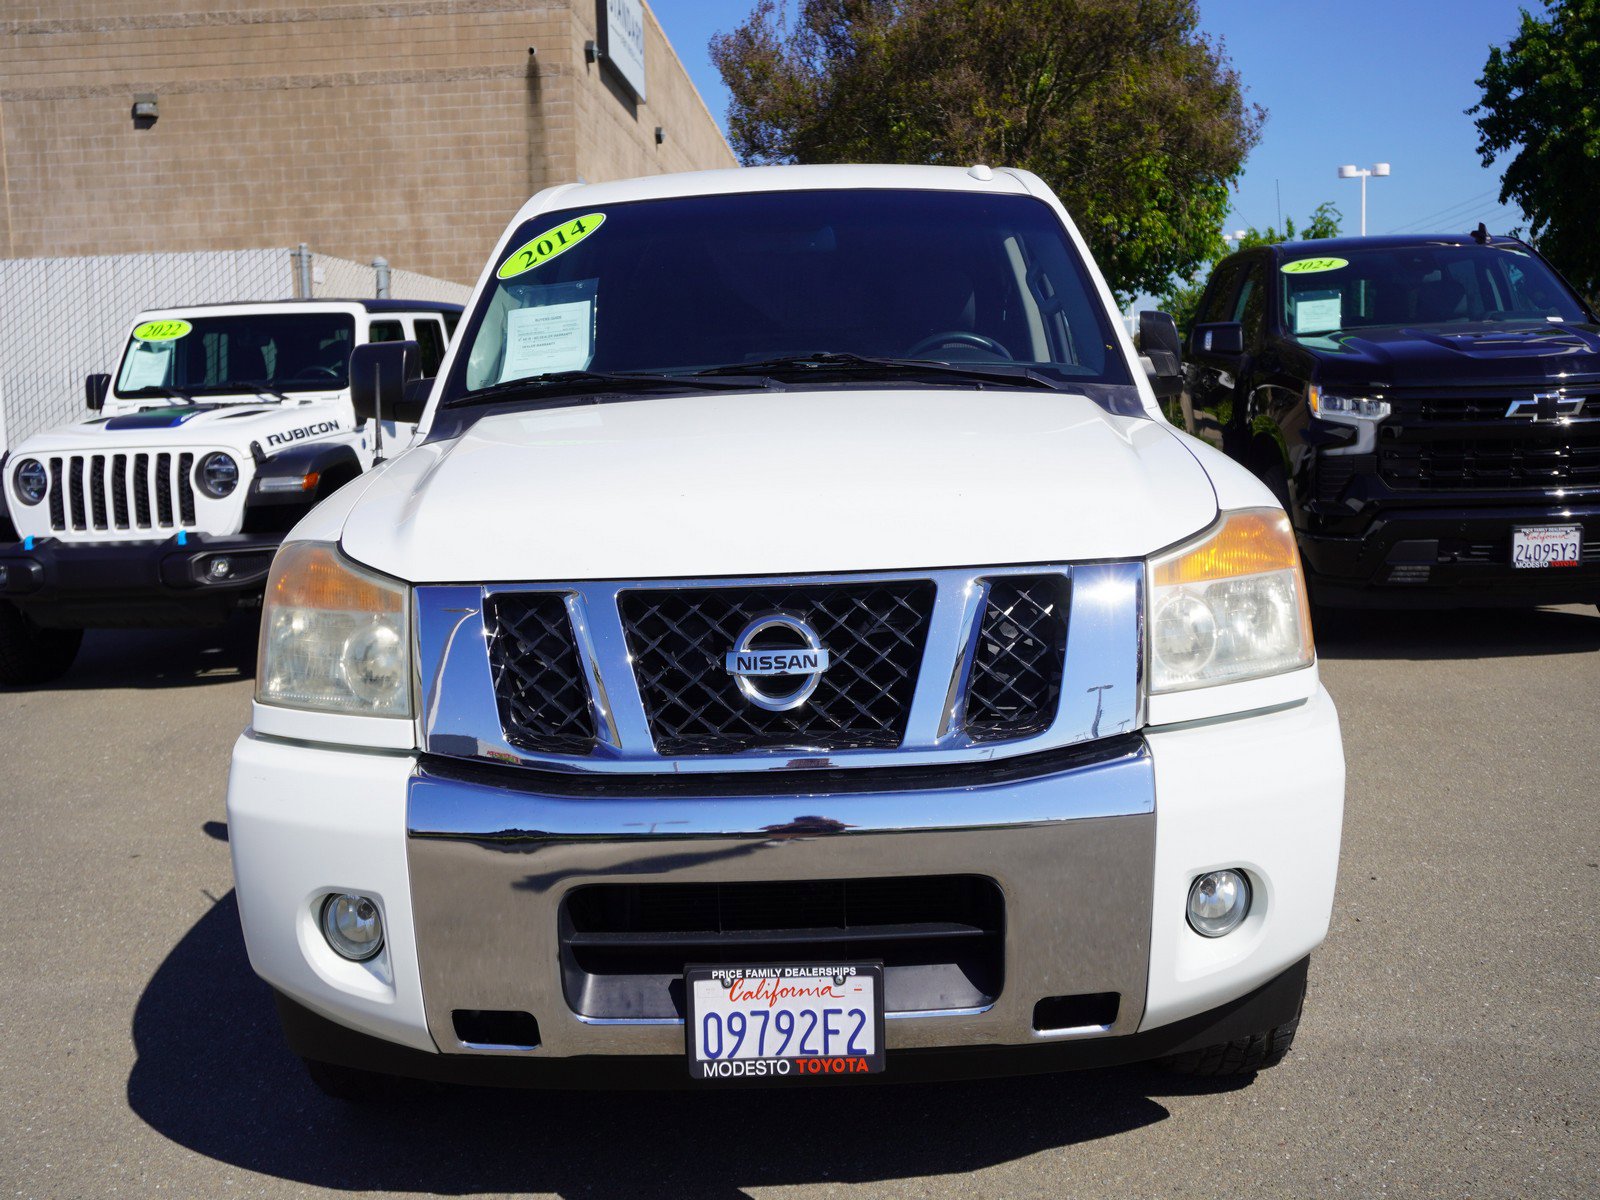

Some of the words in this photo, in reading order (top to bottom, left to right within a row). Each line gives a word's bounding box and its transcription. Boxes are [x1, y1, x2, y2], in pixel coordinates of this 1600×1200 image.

[519, 219, 587, 269] 2014
[1291, 260, 1335, 272] 2024
[142, 323, 182, 338] 2022
[266, 419, 340, 446] RUBICON
[1516, 543, 1577, 562] 24095Y3
[737, 654, 818, 671] NISSAN
[711, 969, 743, 979] PRICE
[745, 968, 783, 978] FAMILY
[784, 967, 857, 977] DEALERSHIPS
[729, 977, 845, 1007] California
[703, 1008, 868, 1060] 09792F2
[703, 1059, 791, 1078] MODESTO
[795, 1057, 869, 1074] TOYOTA
